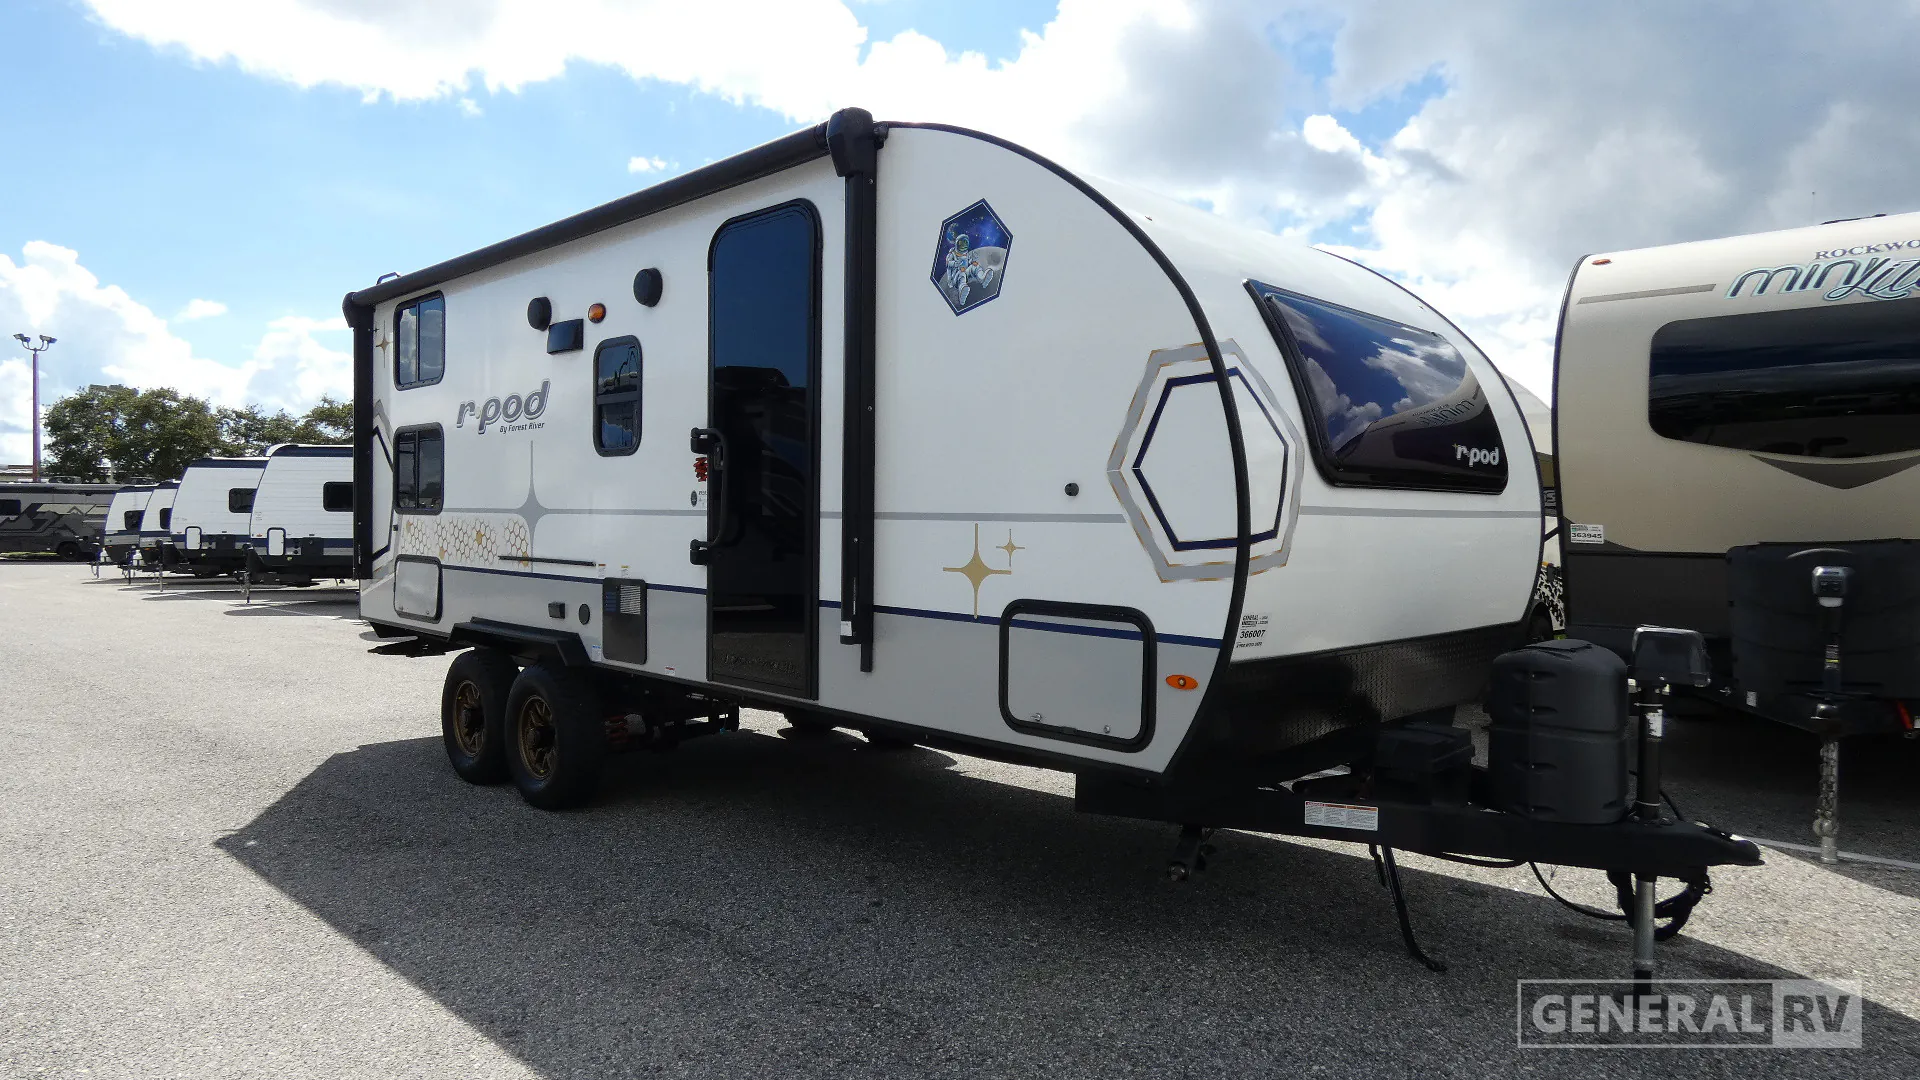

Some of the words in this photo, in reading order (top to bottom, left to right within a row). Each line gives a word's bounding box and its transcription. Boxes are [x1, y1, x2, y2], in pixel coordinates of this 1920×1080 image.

[499, 425, 508, 434] By
[508, 423, 527, 432] Forest
[528, 421, 545, 430] River
[1240, 629, 1266, 639] 366007
